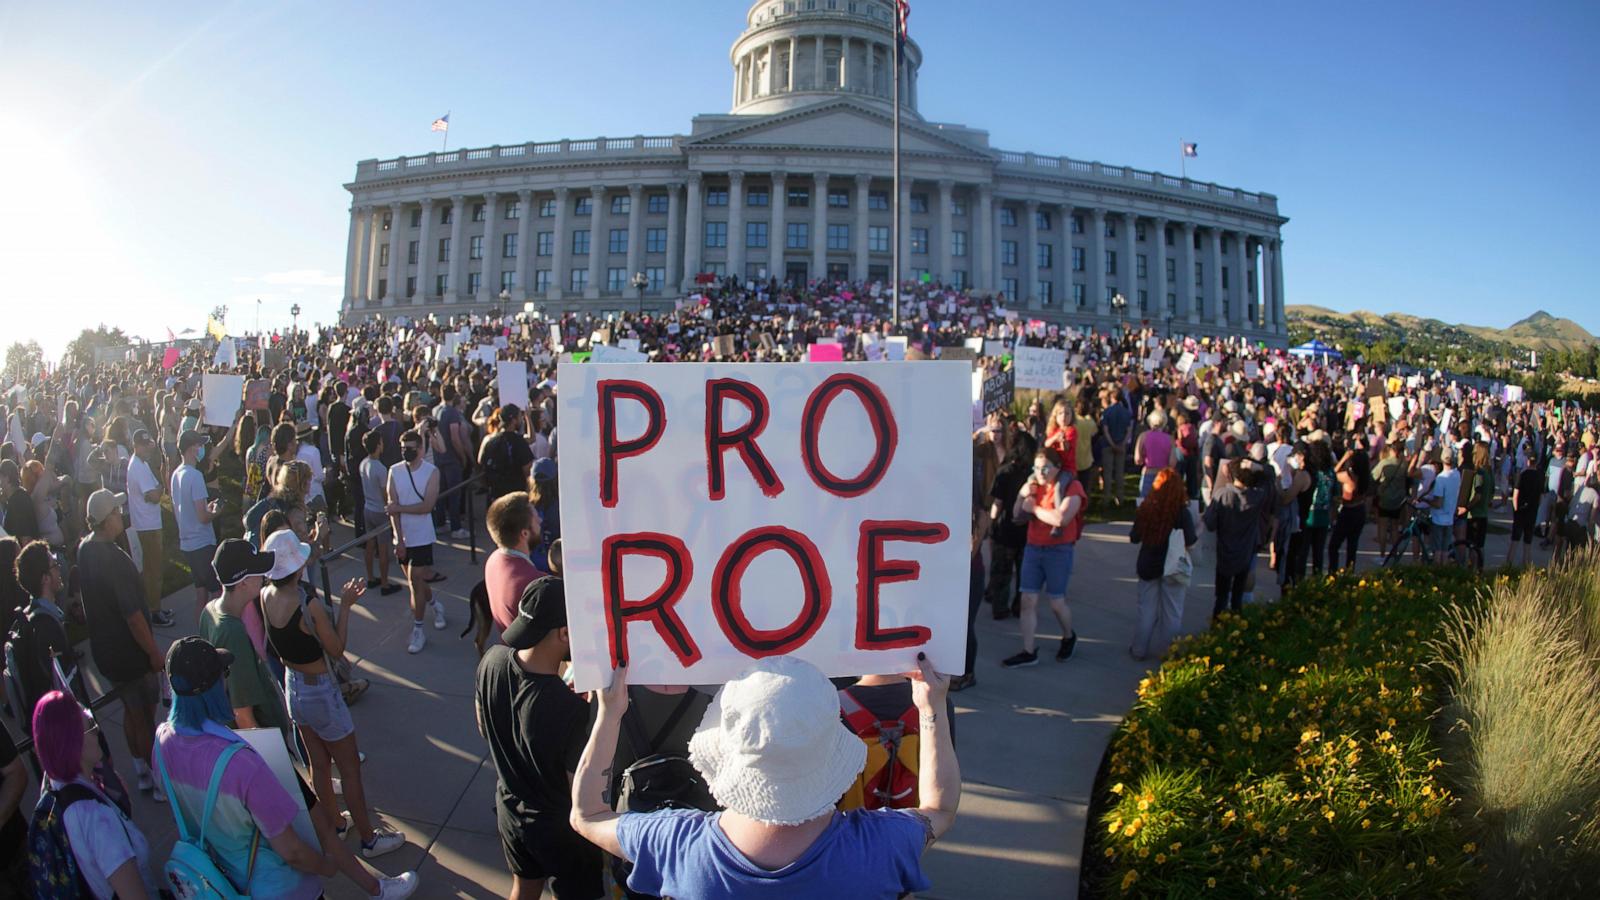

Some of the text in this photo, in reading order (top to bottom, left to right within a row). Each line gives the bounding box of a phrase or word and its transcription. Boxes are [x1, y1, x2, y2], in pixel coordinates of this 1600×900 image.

[984, 369, 1013, 394] ABORT
[984, 391, 1012, 414] COURT
[597, 373, 898, 508] PRO
[602, 519, 950, 670] ROE
